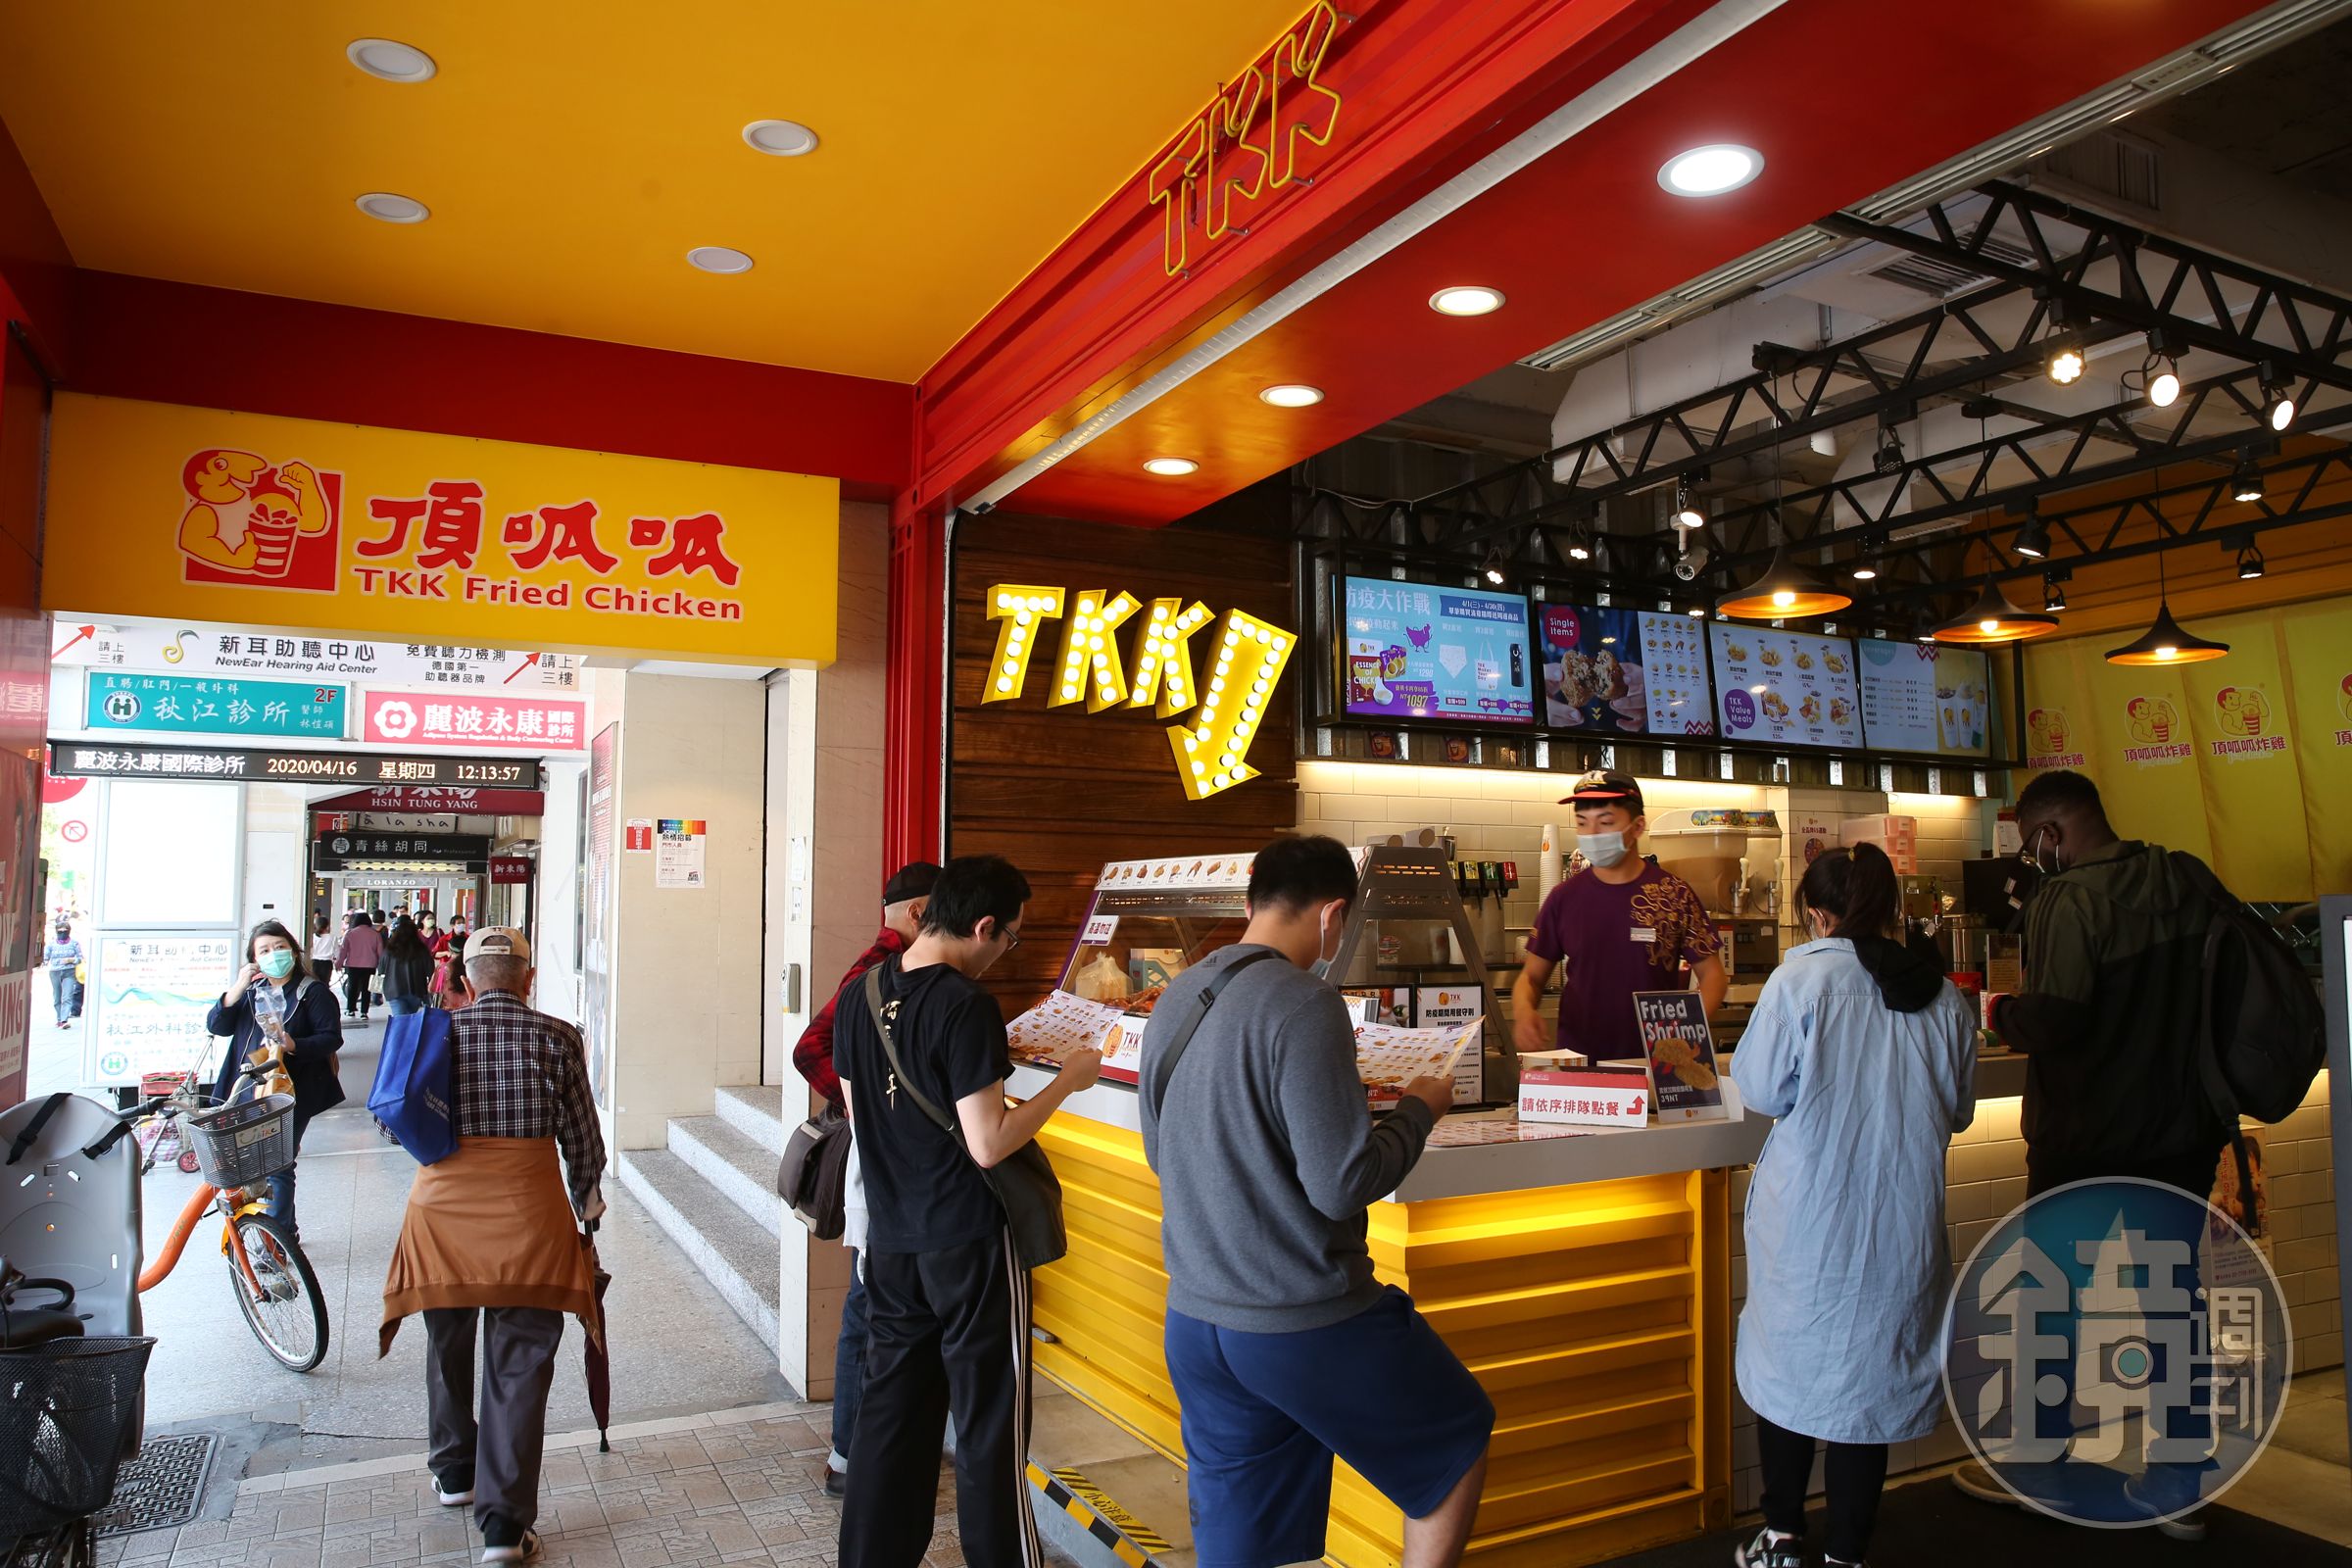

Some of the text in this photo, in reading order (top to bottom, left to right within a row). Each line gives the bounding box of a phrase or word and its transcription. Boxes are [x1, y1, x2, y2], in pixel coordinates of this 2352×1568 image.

[1150, 0, 1342, 275] TKK
[356, 482, 740, 586] 頂呱呱
[354, 567, 741, 619] TKK Fried Chicken
[1549, 617, 1575, 628] Single
[1550, 627, 1574, 637] Items
[98, 641, 124, 653] 請上
[220, 635, 375, 662] 新耳助聽中心
[406, 644, 506, 662] 免費聽力檢測
[986, 583, 1216, 719] TKK
[98, 654, 124, 664] 三樓
[215, 657, 378, 674] NewEar Hearing Aid Center
[432, 661, 479, 671] 德國第一
[542, 654, 573, 669] 請上
[425, 671, 486, 684] 助聽器品牌
[542, 671, 573, 686] 三樓
[315, 688, 337, 704] 2F
[1406, 695, 1429, 708] 1097
[153, 696, 290, 728] 秋江診所
[301, 705, 323, 715] 醫師
[547, 710, 575, 724] 國際
[1730, 706, 1751, 714] Value
[422, 704, 545, 736] 麗波永康
[547, 724, 575, 738] 診所
[2124, 743, 2192, 761] 頂呱呱炸雞
[2211, 736, 2287, 755] 頂呱呱炸雞
[74, 751, 246, 775] 麗波永康國際診所
[268, 758, 358, 775] 2020/04/16
[379, 761, 436, 780] 星期四
[457, 765, 521, 781] 12:13:57
[371, 798, 478, 809] HSIN TUNG YANG
[416, 818, 449, 827] sha
[355, 839, 427, 854] 青絲胡同
[494, 864, 526, 874] 新東陽
[130, 945, 227, 956] 新耳助中心
[1640, 1000, 1688, 1020] Fried
[107, 1022, 207, 1037] 秋江外科診
[1645, 1021, 1706, 1043] Shrimp
[1124, 1032, 1143, 1048] TKK
[1522, 1097, 1619, 1117] 請依序排隊點餐
